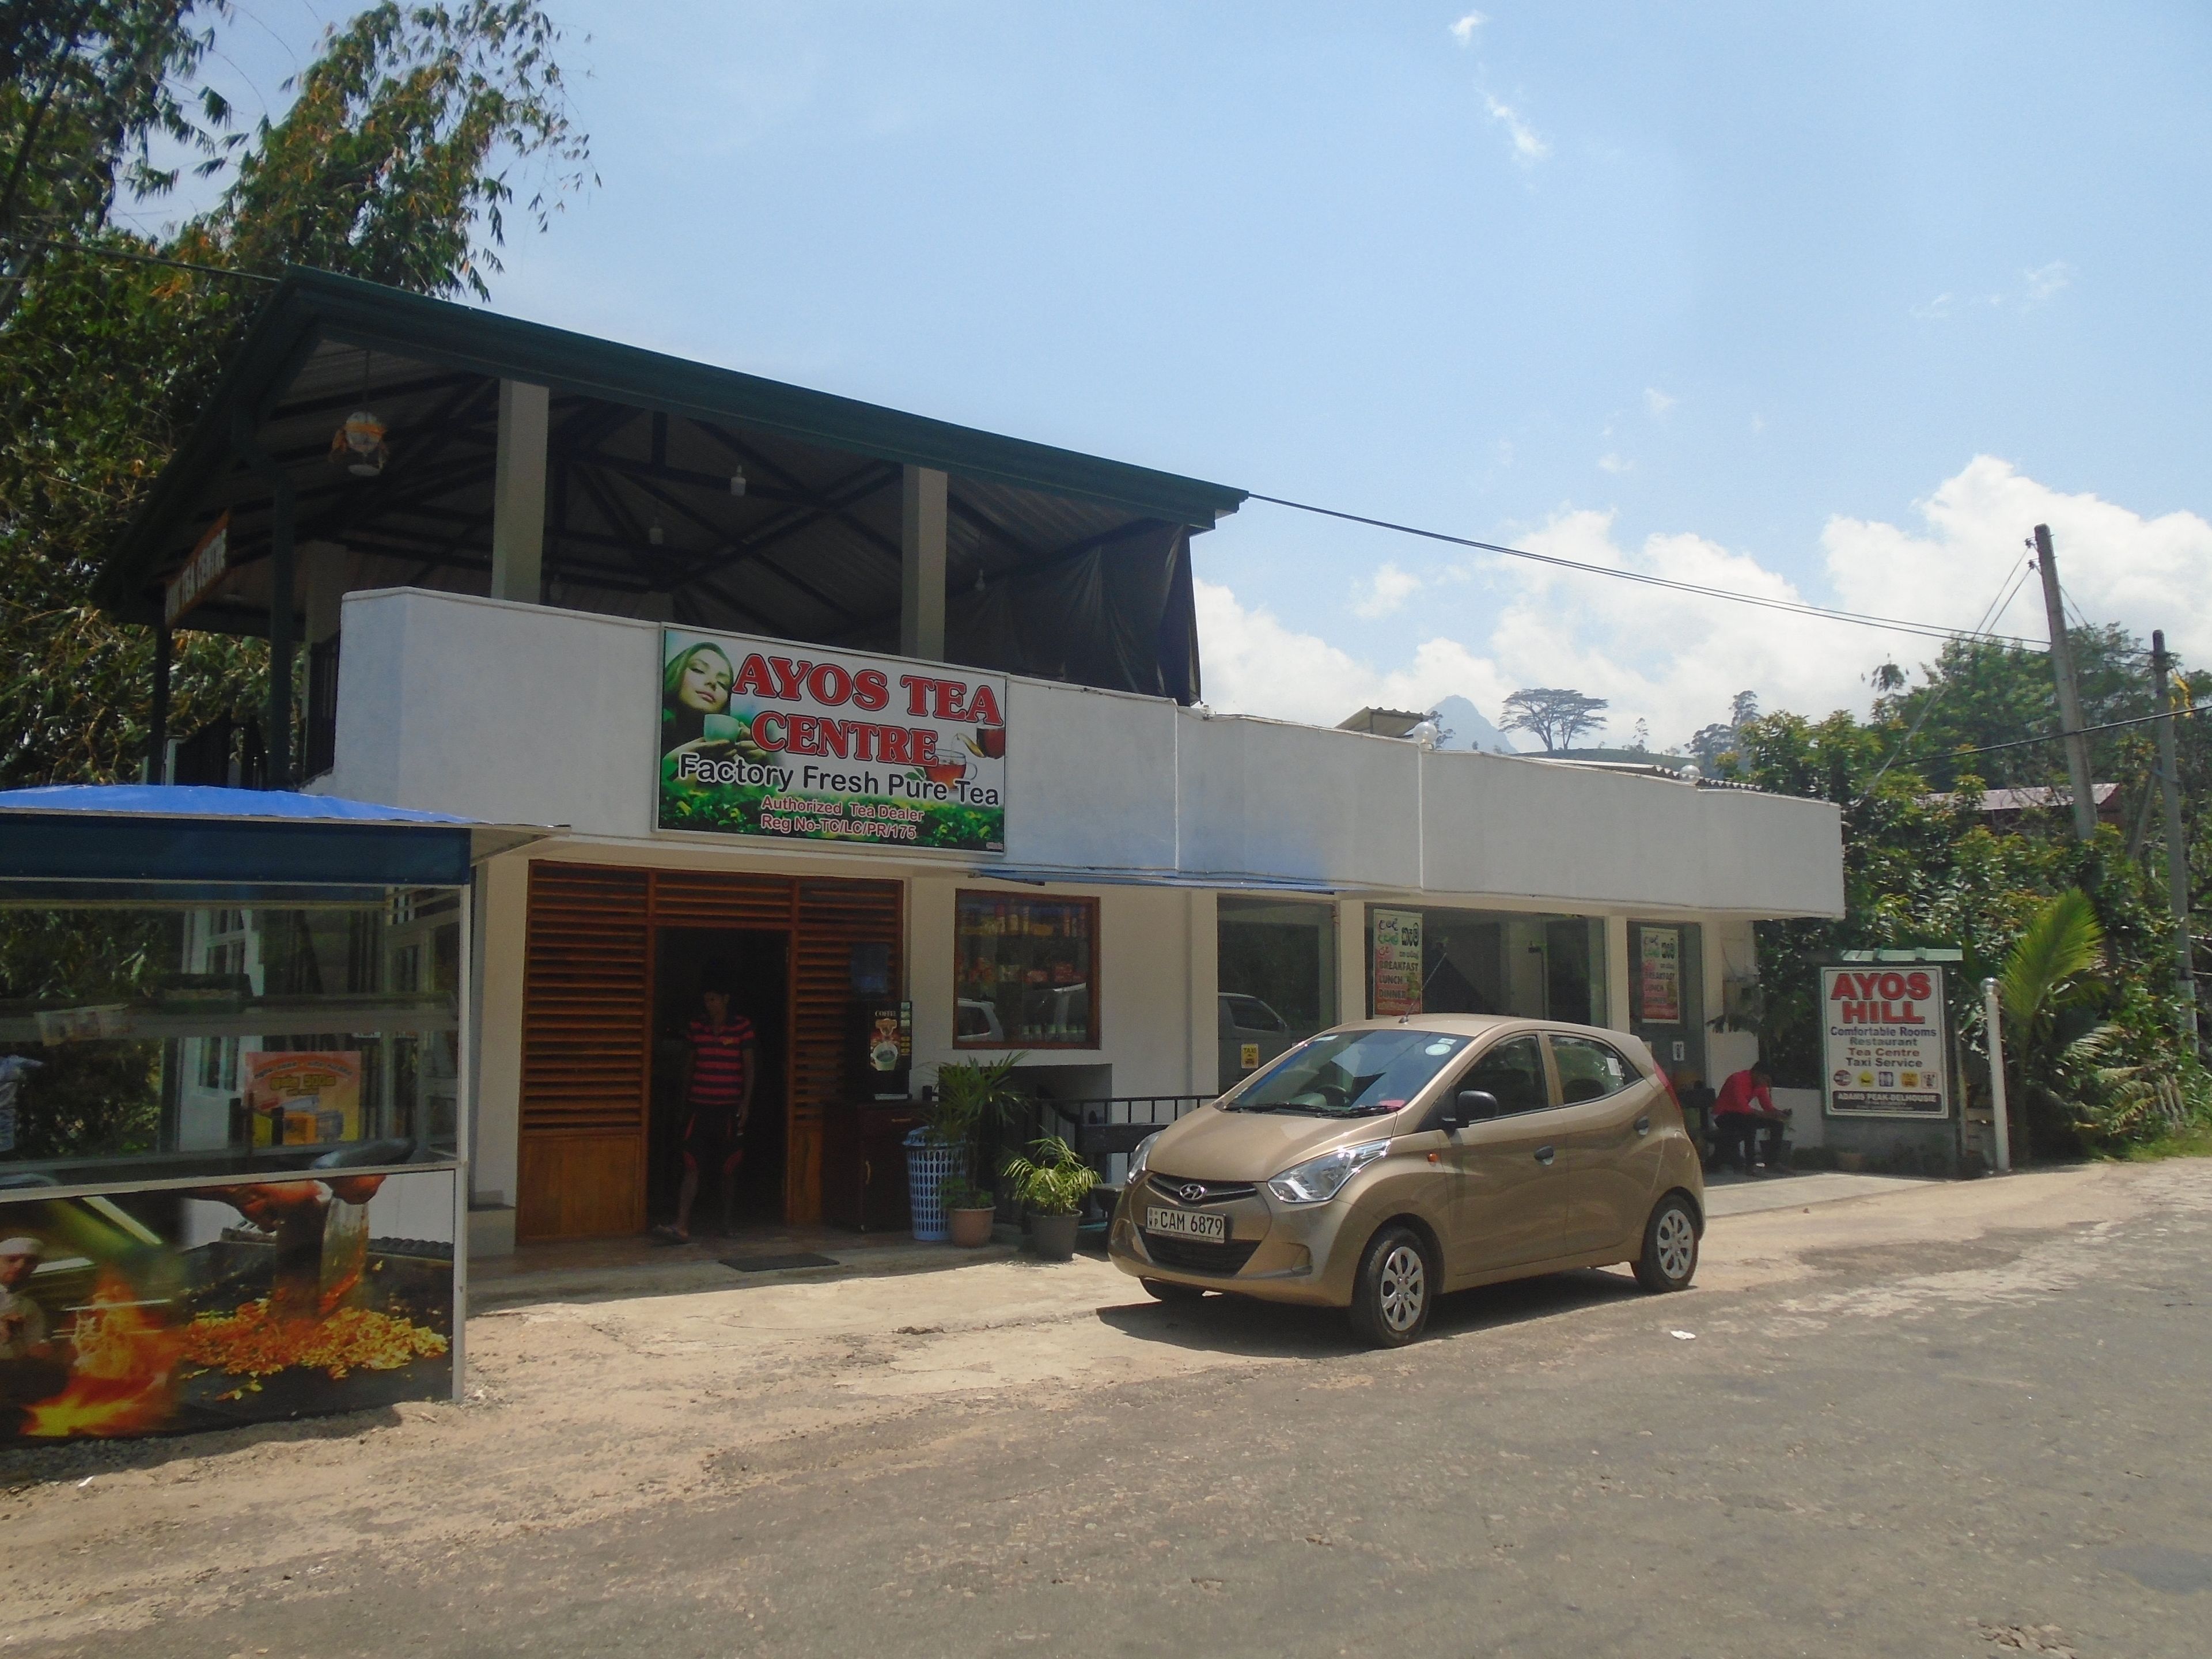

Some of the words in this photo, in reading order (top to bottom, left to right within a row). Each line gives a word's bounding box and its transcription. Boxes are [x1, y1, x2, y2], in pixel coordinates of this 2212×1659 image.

[732, 653, 889, 711] AYOS
[900, 675, 1003, 726] TEA
[751, 710, 939, 767] CENTRE
[680, 753, 794, 793] Factory
[804, 765, 879, 795] Fresh
[888, 773, 948, 801] Pure
[954, 779, 999, 806] Tea
[761, 795, 843, 815] Authorized
[850, 802, 874, 817] Tea
[878, 804, 925, 822] Dealer
[761, 813, 791, 834] Reg
[794, 816, 917, 840] No-TC/LC/PR/175
[1379, 960, 1419, 972] BREAKFAST
[1379, 974, 1403, 984] LUNCH
[1830, 972, 1931, 1001] AYOS
[1379, 988, 1407, 999] DINNER
[1842, 1001, 1925, 1024] HILL
[1830, 1027, 1896, 1036] Comfortable
[1900, 1027, 1937, 1037] Rooms
[1849, 1037, 1918, 1046] Restaurant
[1846, 1057, 1871, 1067] Taxi
[1875, 1058, 1923, 1067] Service
[1848, 1047, 1871, 1056] Tea
[1876, 1047, 1920, 1056] Centre
[1160, 1211, 1185, 1231] CAM
[1190, 1215, 1223, 1236] 6879
